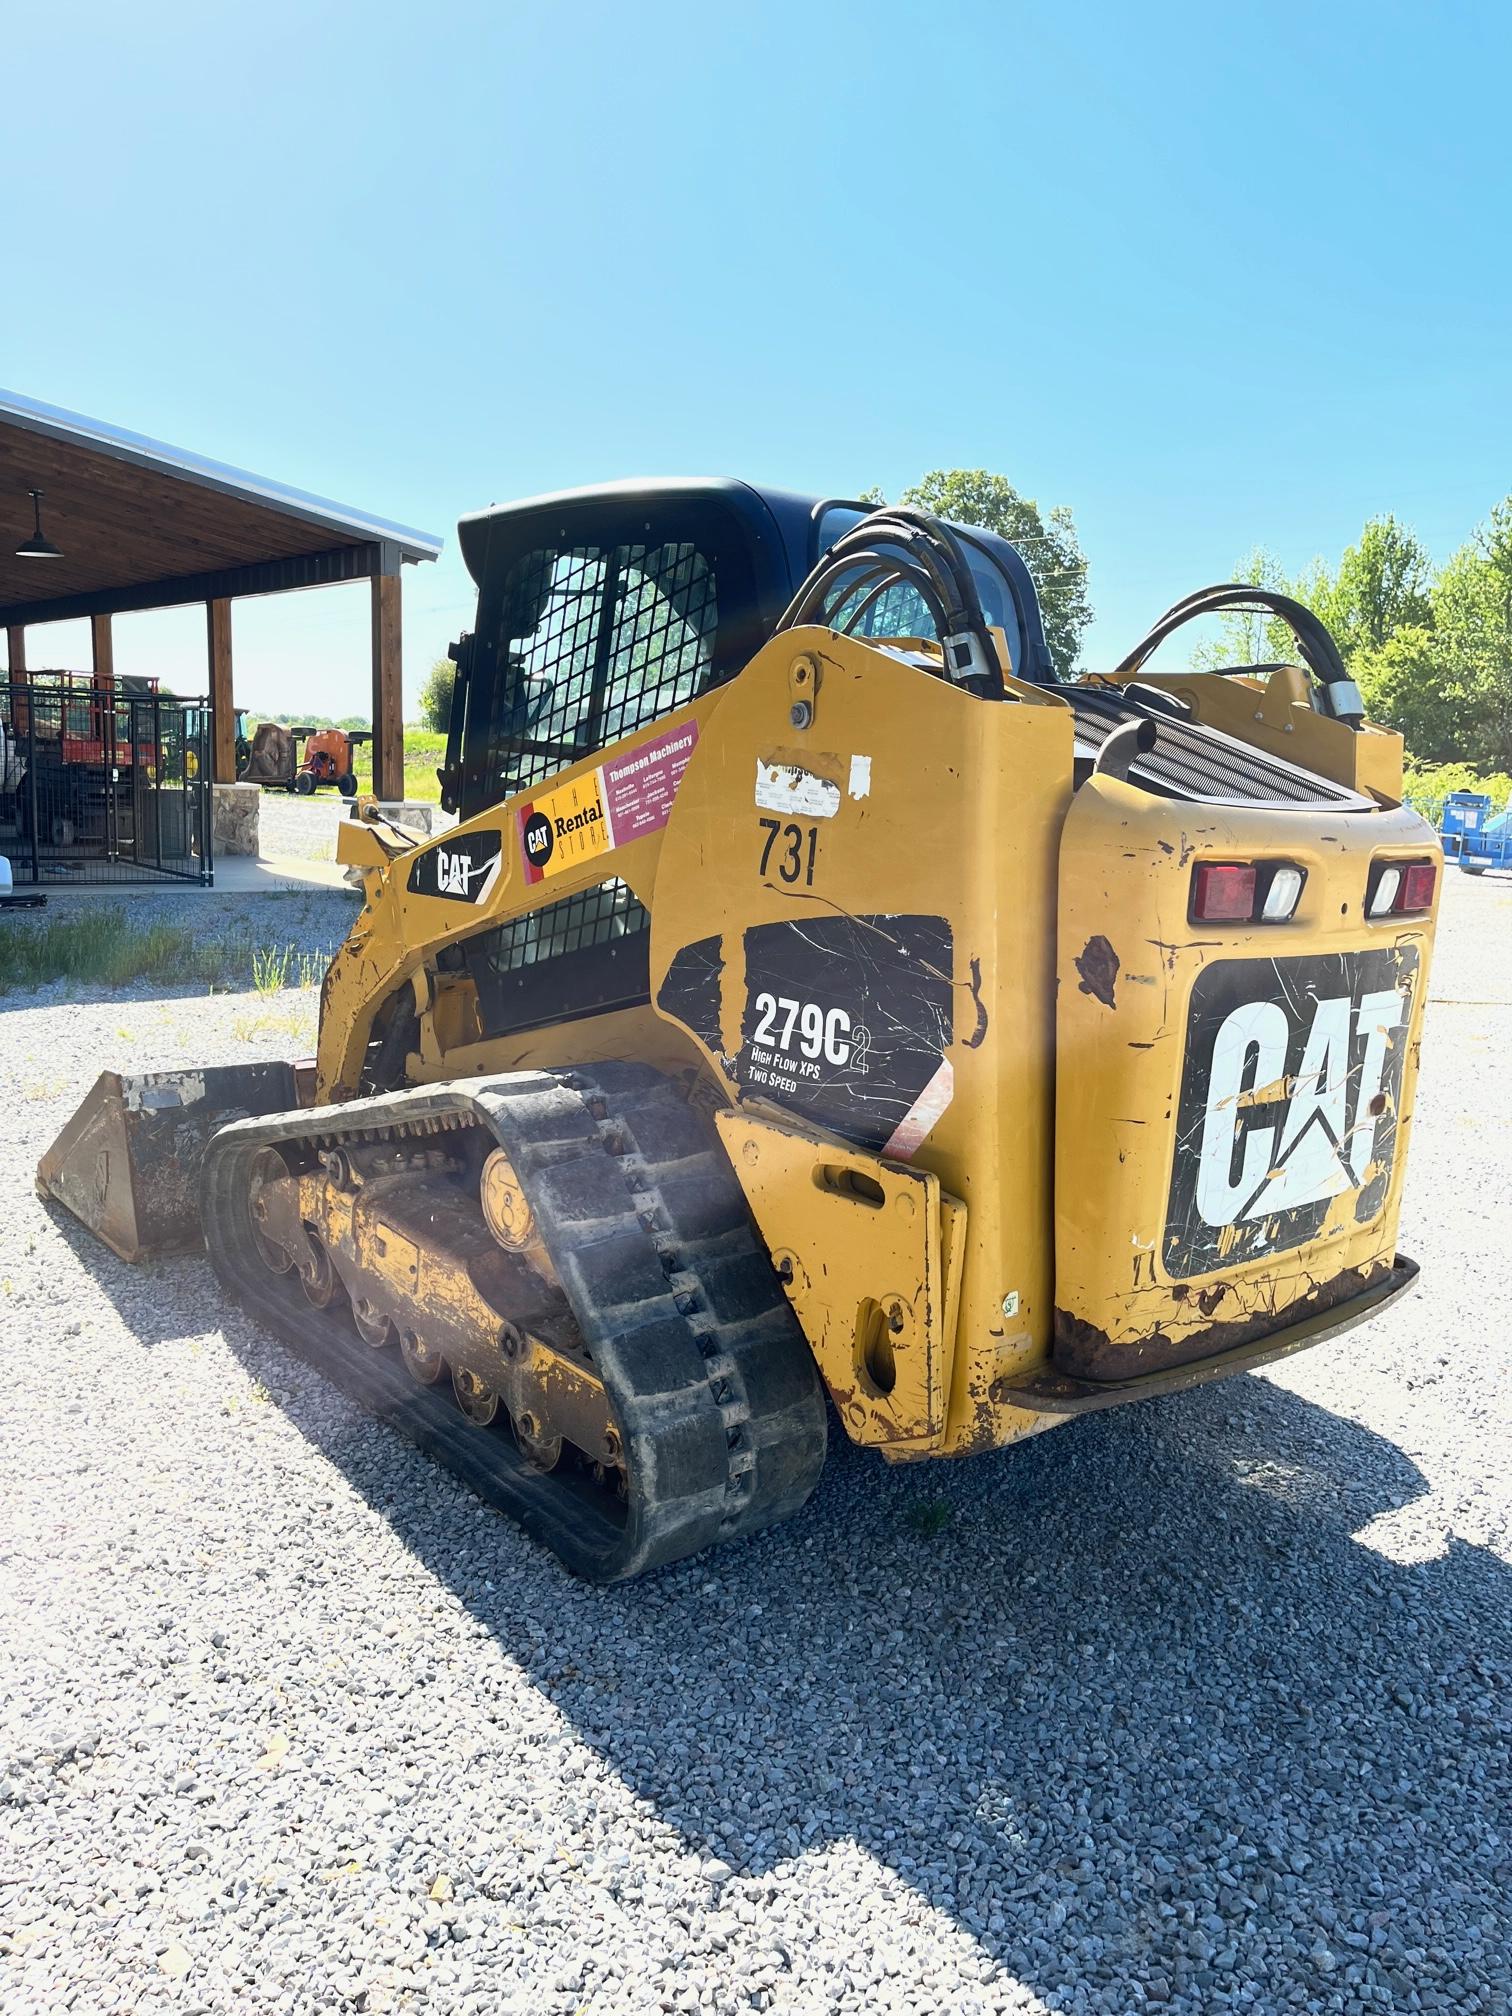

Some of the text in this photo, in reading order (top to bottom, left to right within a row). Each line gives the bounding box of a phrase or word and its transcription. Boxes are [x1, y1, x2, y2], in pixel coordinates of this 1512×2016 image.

[609, 756, 650, 782] Thompson
[649, 735, 693, 764] Machinery
[527, 825, 548, 854] CAT
[554, 799, 604, 838] Rental
[437, 851, 472, 896] CAT
[759, 817, 818, 886] 731
[799, 1060, 821, 1079] XPS
[1197, 989, 1402, 1227] CAT
